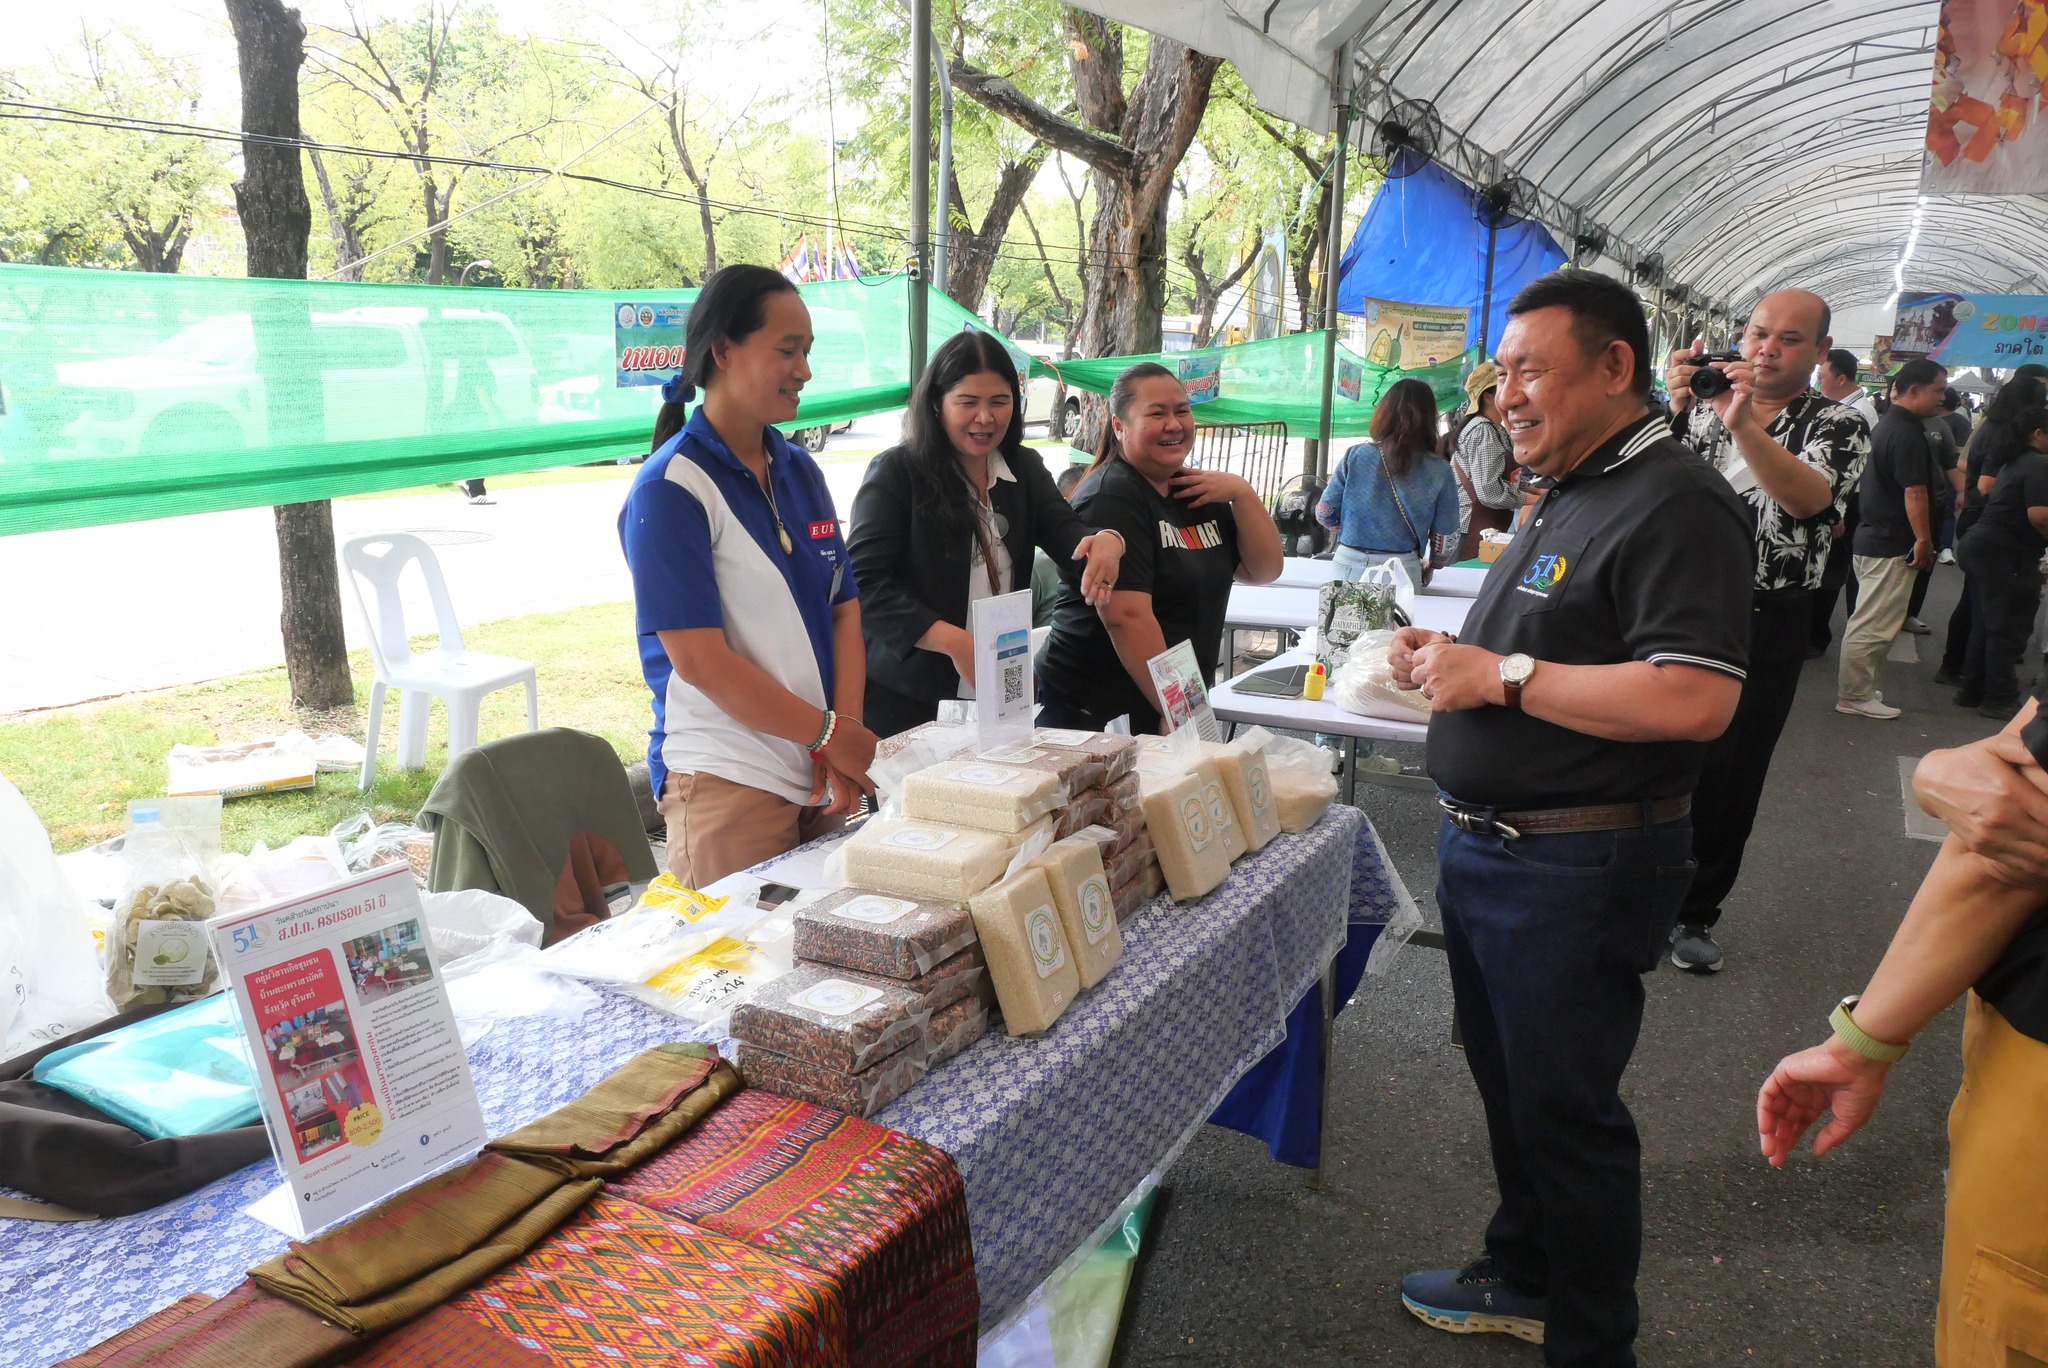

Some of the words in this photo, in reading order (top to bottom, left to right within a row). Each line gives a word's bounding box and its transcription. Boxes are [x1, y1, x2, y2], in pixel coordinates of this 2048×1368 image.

[1994, 334, 2046, 355] ภาคใต้
[1523, 554, 1558, 584] 51
[275, 900, 340, 926] วันคล้ายวันสถาปนา
[278, 923, 315, 942] ส.ป.ก.
[317, 906, 362, 929] ครบรอบ
[364, 898, 376, 914] 51
[377, 893, 388, 908] ปี
[254, 956, 319, 985] กลุ่มวิสาหกิจชุมชน
[264, 998, 290, 1015] จังหวัด
[290, 987, 316, 1007] สุรินทร์
[353, 1111, 370, 1122] PRICE
